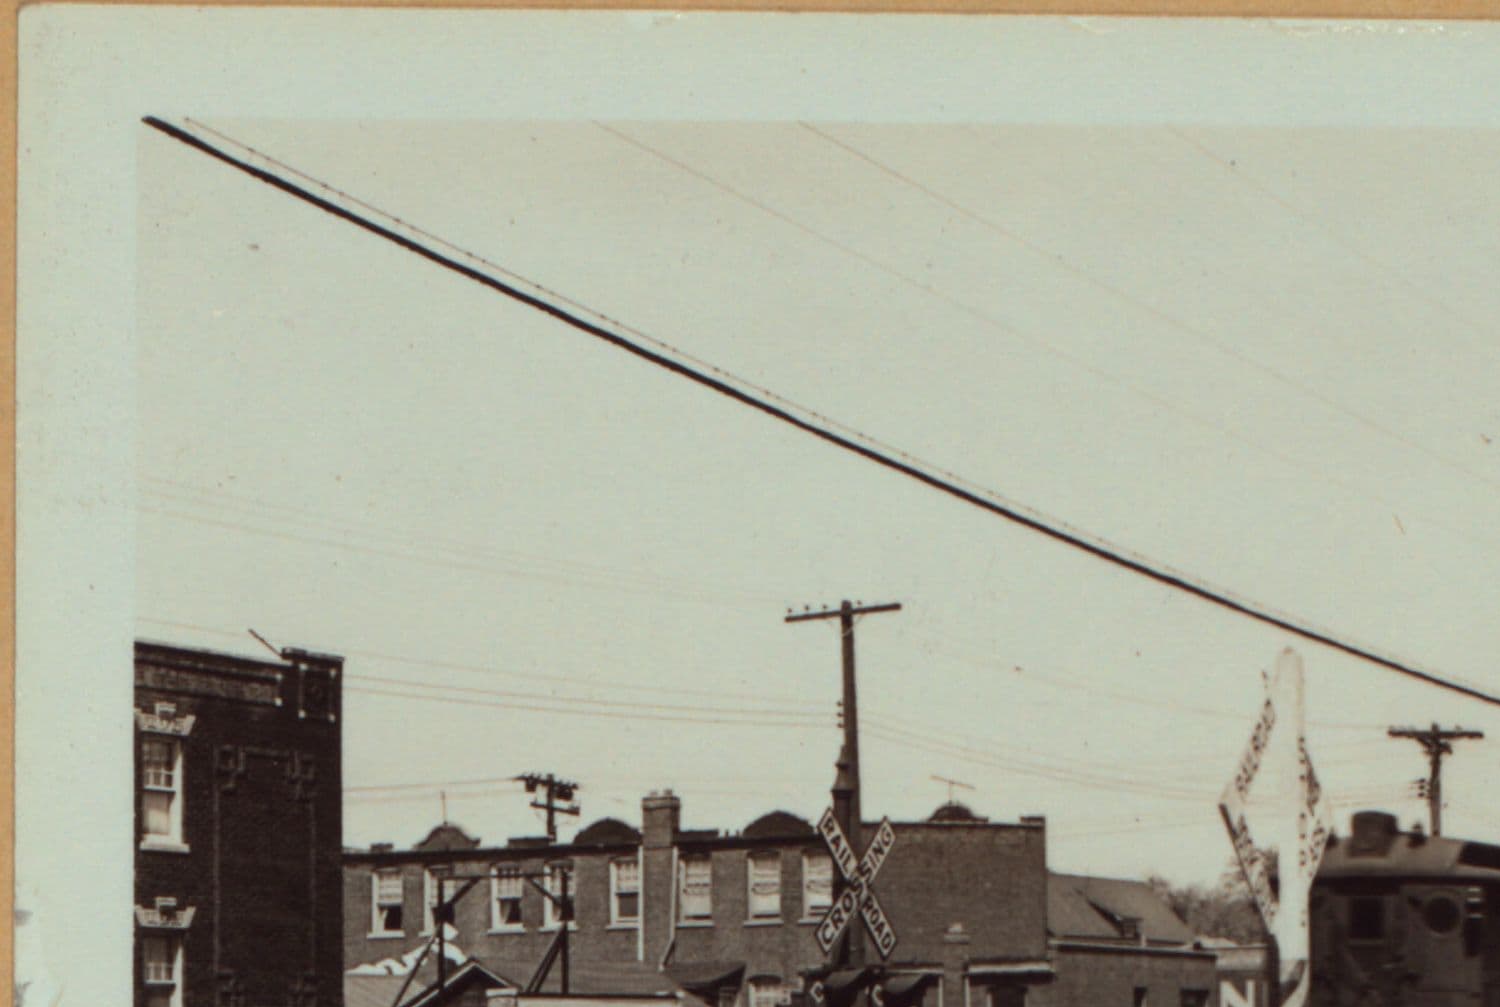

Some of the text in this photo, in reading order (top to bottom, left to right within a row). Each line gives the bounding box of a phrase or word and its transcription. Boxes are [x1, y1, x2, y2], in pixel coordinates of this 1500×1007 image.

[820, 825, 893, 945] CROSSING
[823, 816, 893, 951] RAIL ROAD
